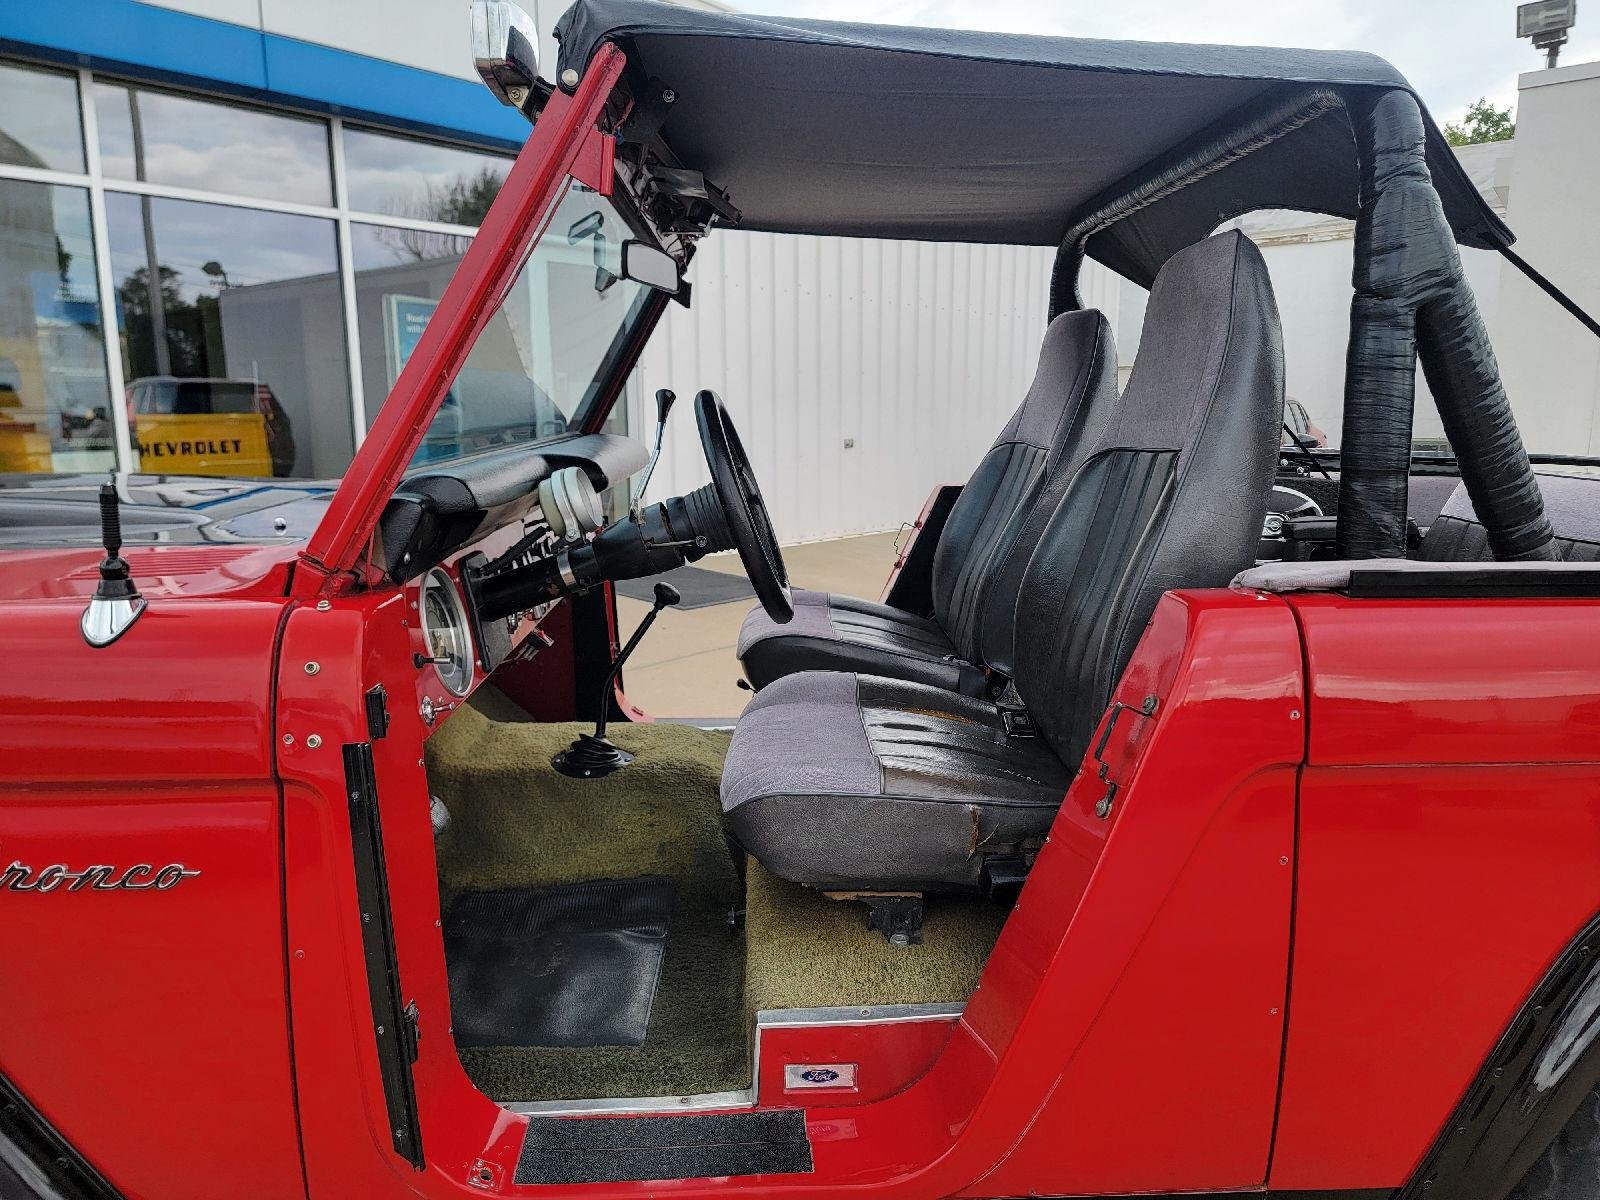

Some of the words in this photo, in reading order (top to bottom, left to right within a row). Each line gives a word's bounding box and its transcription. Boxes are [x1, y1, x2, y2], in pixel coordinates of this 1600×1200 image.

[139, 439, 241, 457] HEVROLET
[0, 861, 200, 892] ronco
[808, 1070, 833, 1081] Ford
